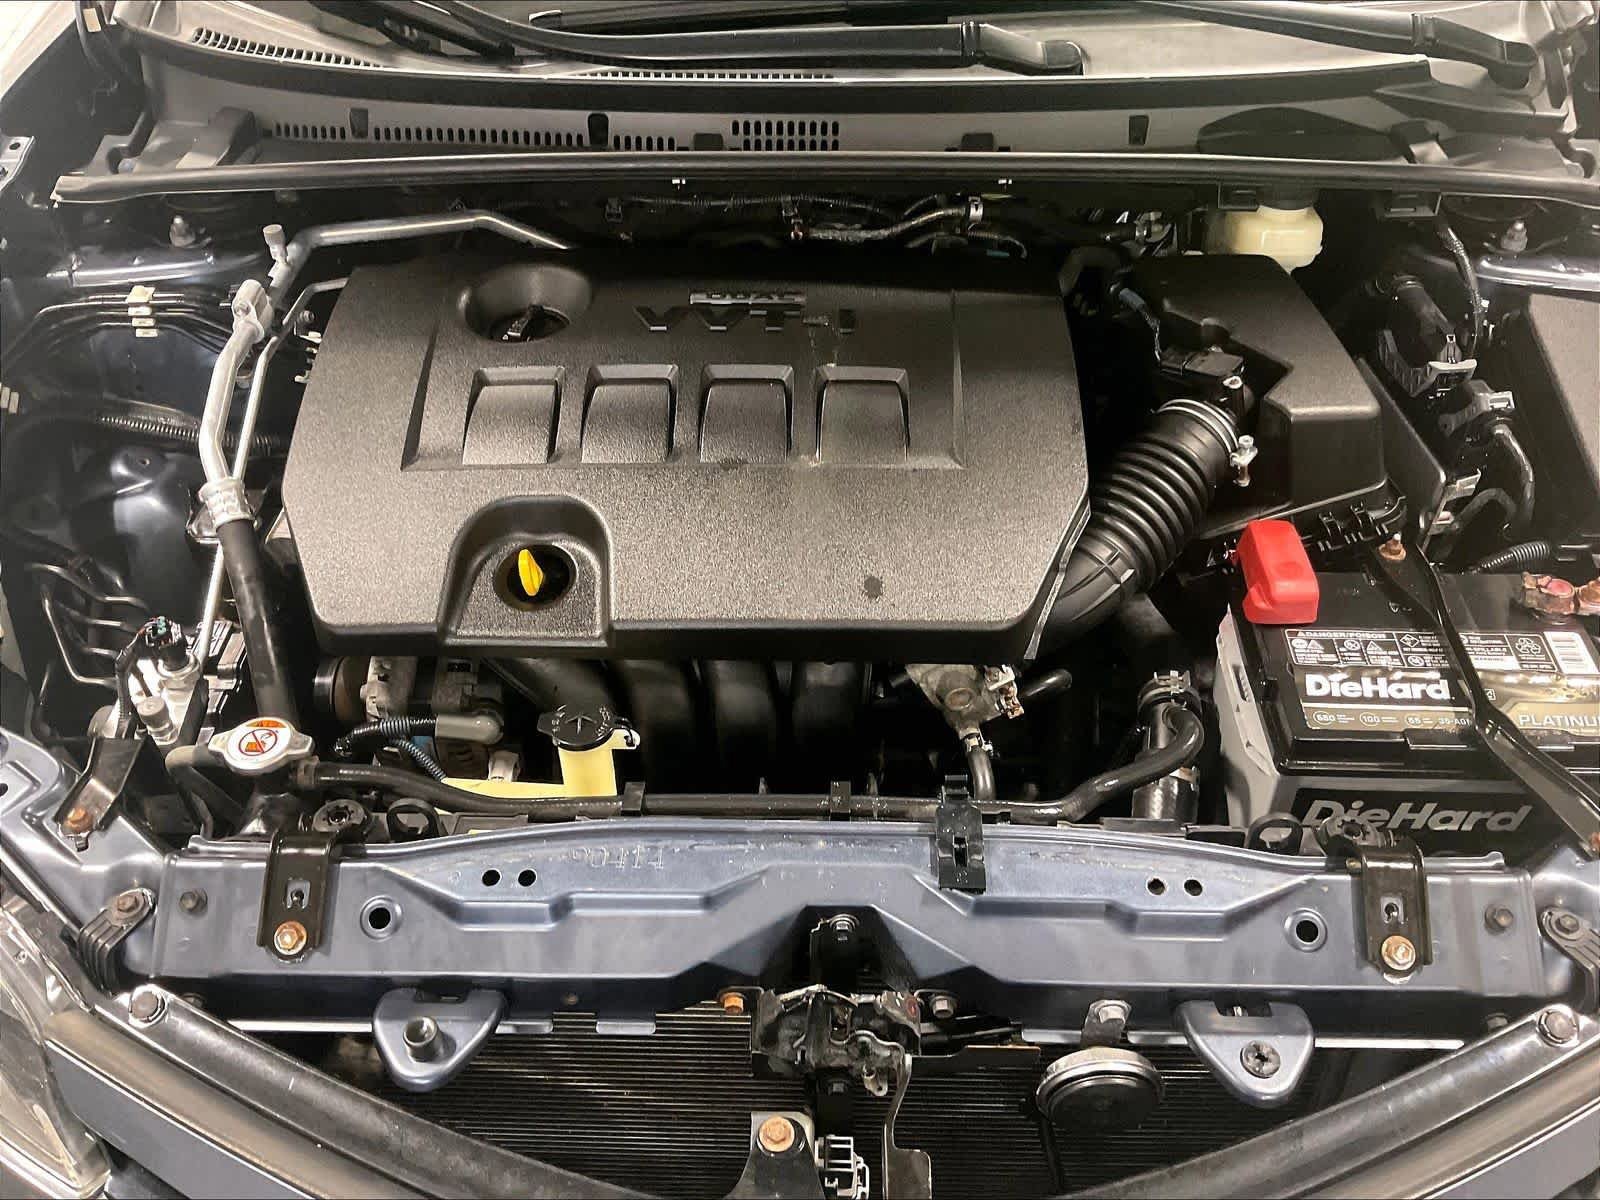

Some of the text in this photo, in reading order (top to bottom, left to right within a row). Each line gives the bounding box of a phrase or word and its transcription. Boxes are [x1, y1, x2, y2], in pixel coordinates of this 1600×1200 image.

[1304, 672, 1451, 700] DieHard
[1518, 713, 1600, 729] PLATINU
[1301, 799, 1533, 832] DieHard
